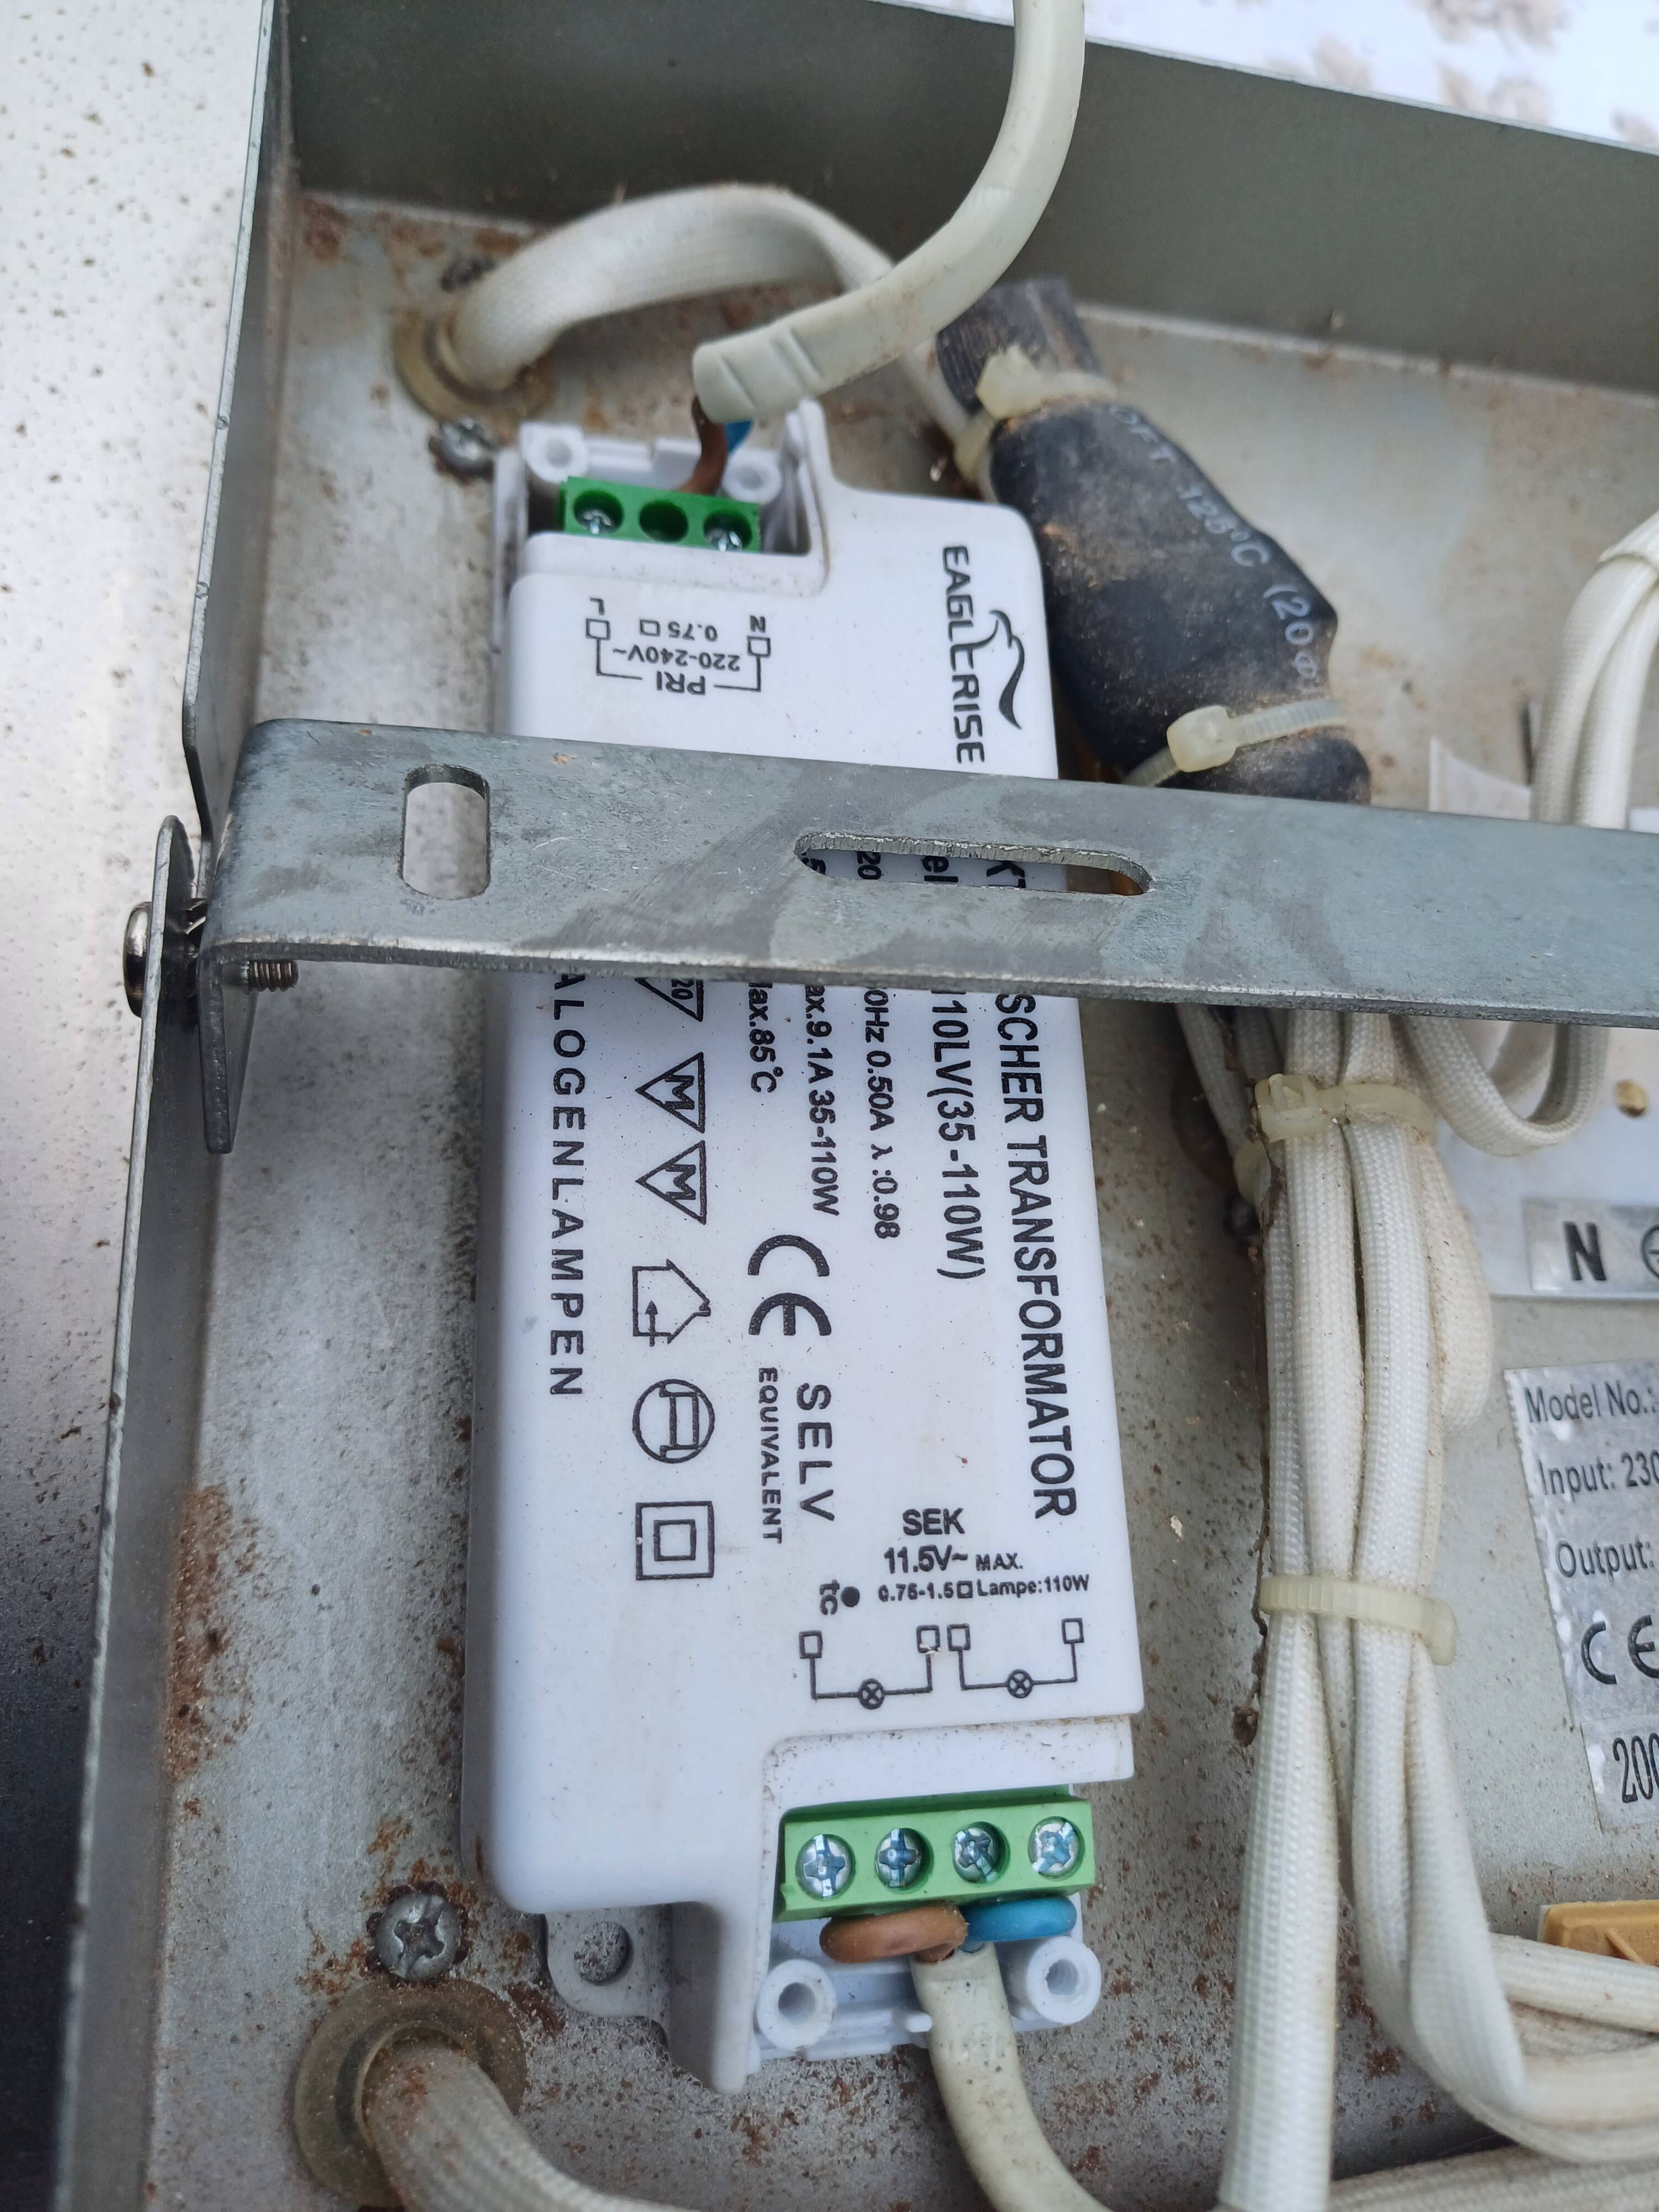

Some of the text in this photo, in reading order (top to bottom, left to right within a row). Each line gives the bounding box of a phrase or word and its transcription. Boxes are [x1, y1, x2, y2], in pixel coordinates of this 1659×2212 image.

[590, 598, 605, 615] L
[750, 615, 766, 633] N
[668, 621, 718, 642] 0.75
[942, 545, 985, 764] EAGLERISE
[656, 671, 706, 695] PRI
[864, 987, 889, 1043] 0Hz
[867, 1050, 894, 1130] 0.50A
[808, 1089, 839, 1215] 35-110W
[1563, 1220, 1606, 1281] N
[1007, 1135, 1077, 1519] TRANSFORMATOR
[1524, 1384, 1600, 1423] Model
[759, 1367, 782, 1543] EQUIVALENT
[797, 1383, 834, 1521] SELV
[1536, 1455, 1615, 1503] Input:
[902, 1508, 964, 1536] SEK
[975, 1553, 1023, 1571] MAX.
[1556, 1533, 1654, 1582] Output:
